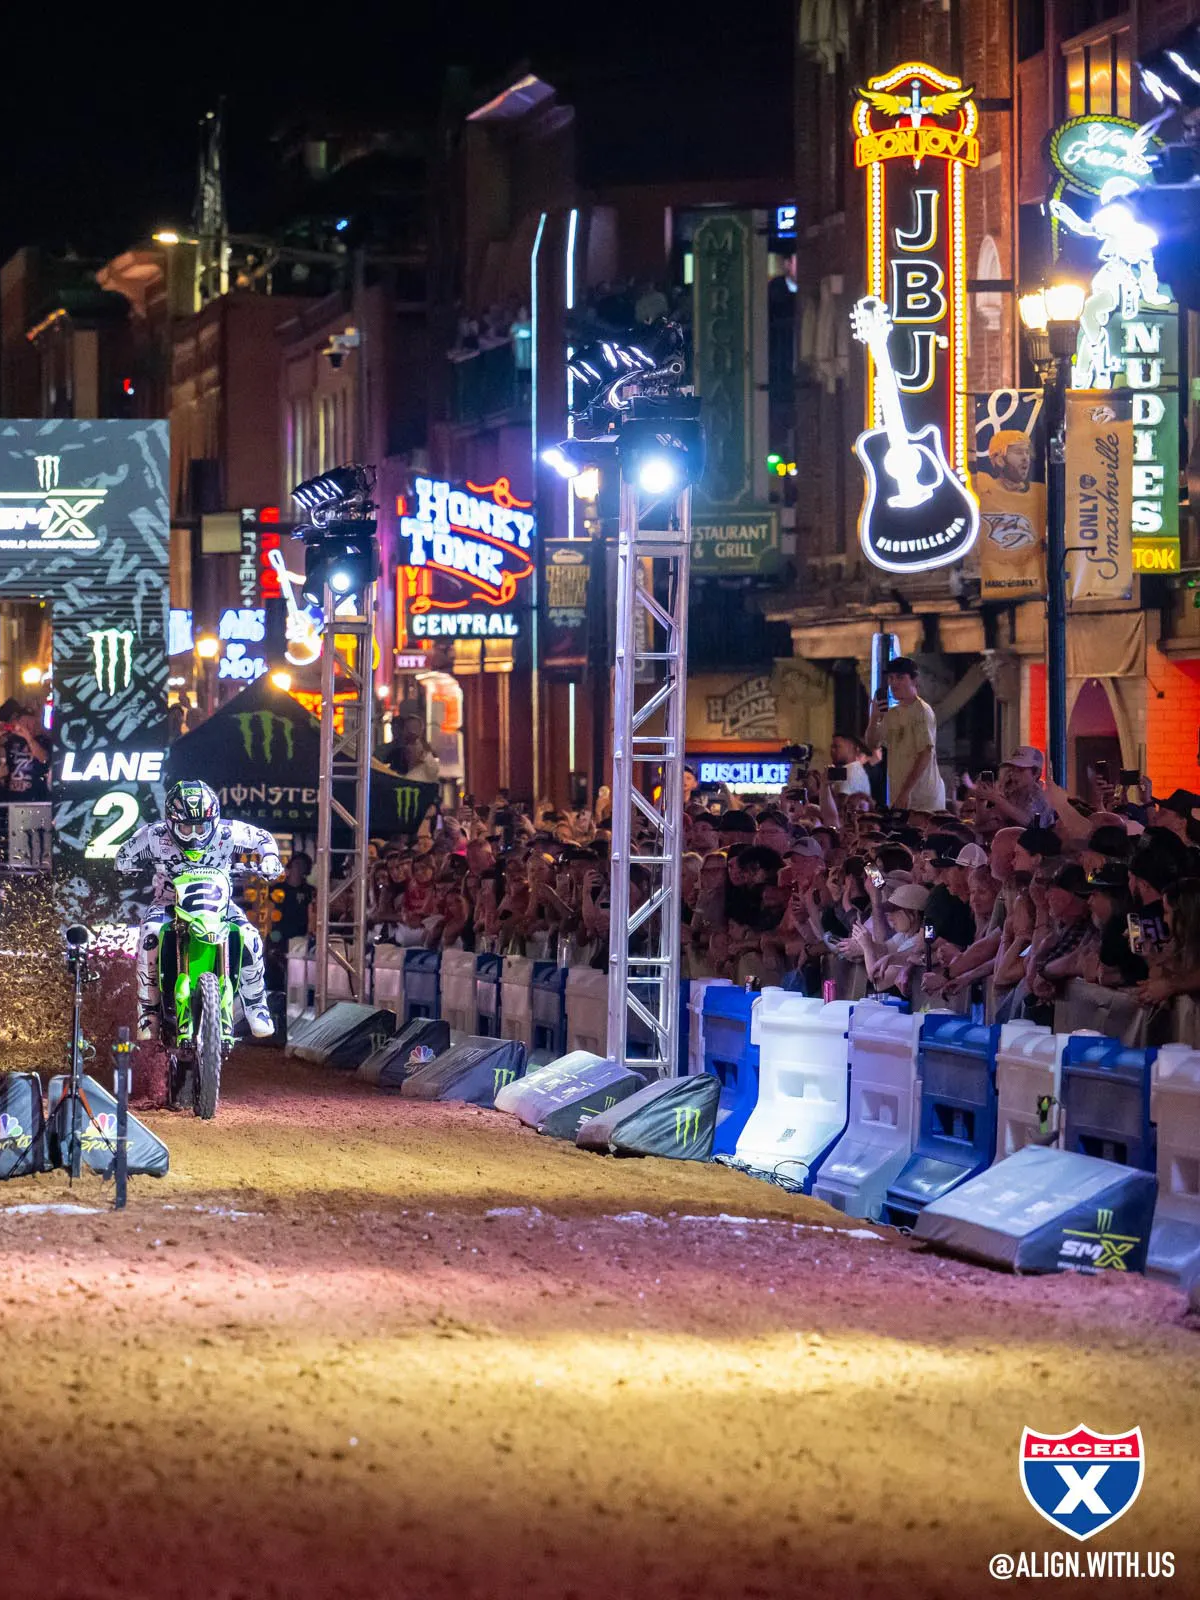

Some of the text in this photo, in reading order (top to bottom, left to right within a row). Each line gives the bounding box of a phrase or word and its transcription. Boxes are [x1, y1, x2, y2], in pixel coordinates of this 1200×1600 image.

[1121, 322, 1165, 534] NUDIES
[416, 478, 534, 548] HONKY
[1079, 493, 1099, 541] ONLY
[1086, 431, 1120, 580] Smashville
[240, 508, 257, 596] KTCHEN
[401, 517, 503, 586] TONK
[714, 542, 755, 558] GRILL
[1132, 548, 1175, 569] TONK
[413, 614, 519, 636] CENTRAL
[61, 752, 164, 780] LANE
[701, 763, 750, 783] BUSCH
[216, 784, 319, 805] MONSTE
[84, 791, 139, 859] 2
[181, 882, 223, 912] 2
[1059, 1239, 1135, 1270] SMX
